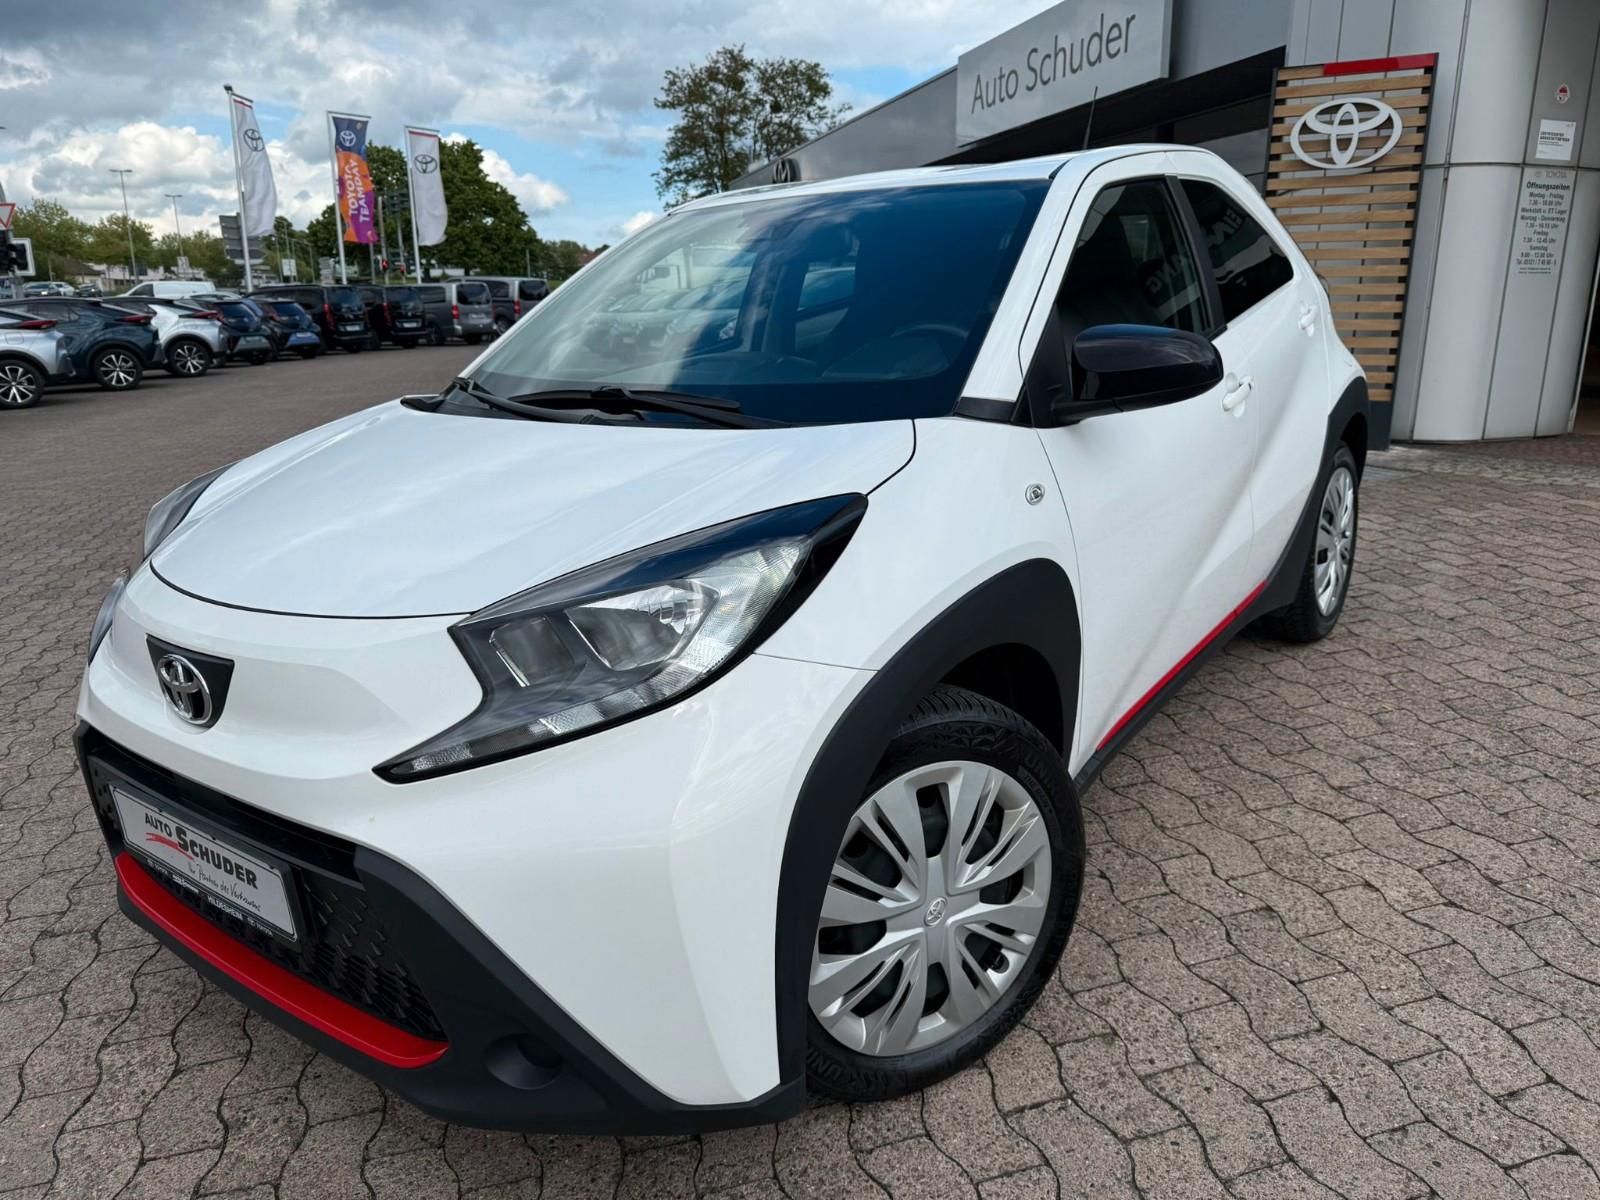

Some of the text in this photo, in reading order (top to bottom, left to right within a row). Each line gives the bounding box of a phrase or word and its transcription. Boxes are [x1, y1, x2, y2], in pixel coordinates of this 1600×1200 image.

[970, 13, 1136, 114] Auto Schuder
[144, 812, 173, 837] AUTO
[174, 825, 259, 890] SCHUDER
